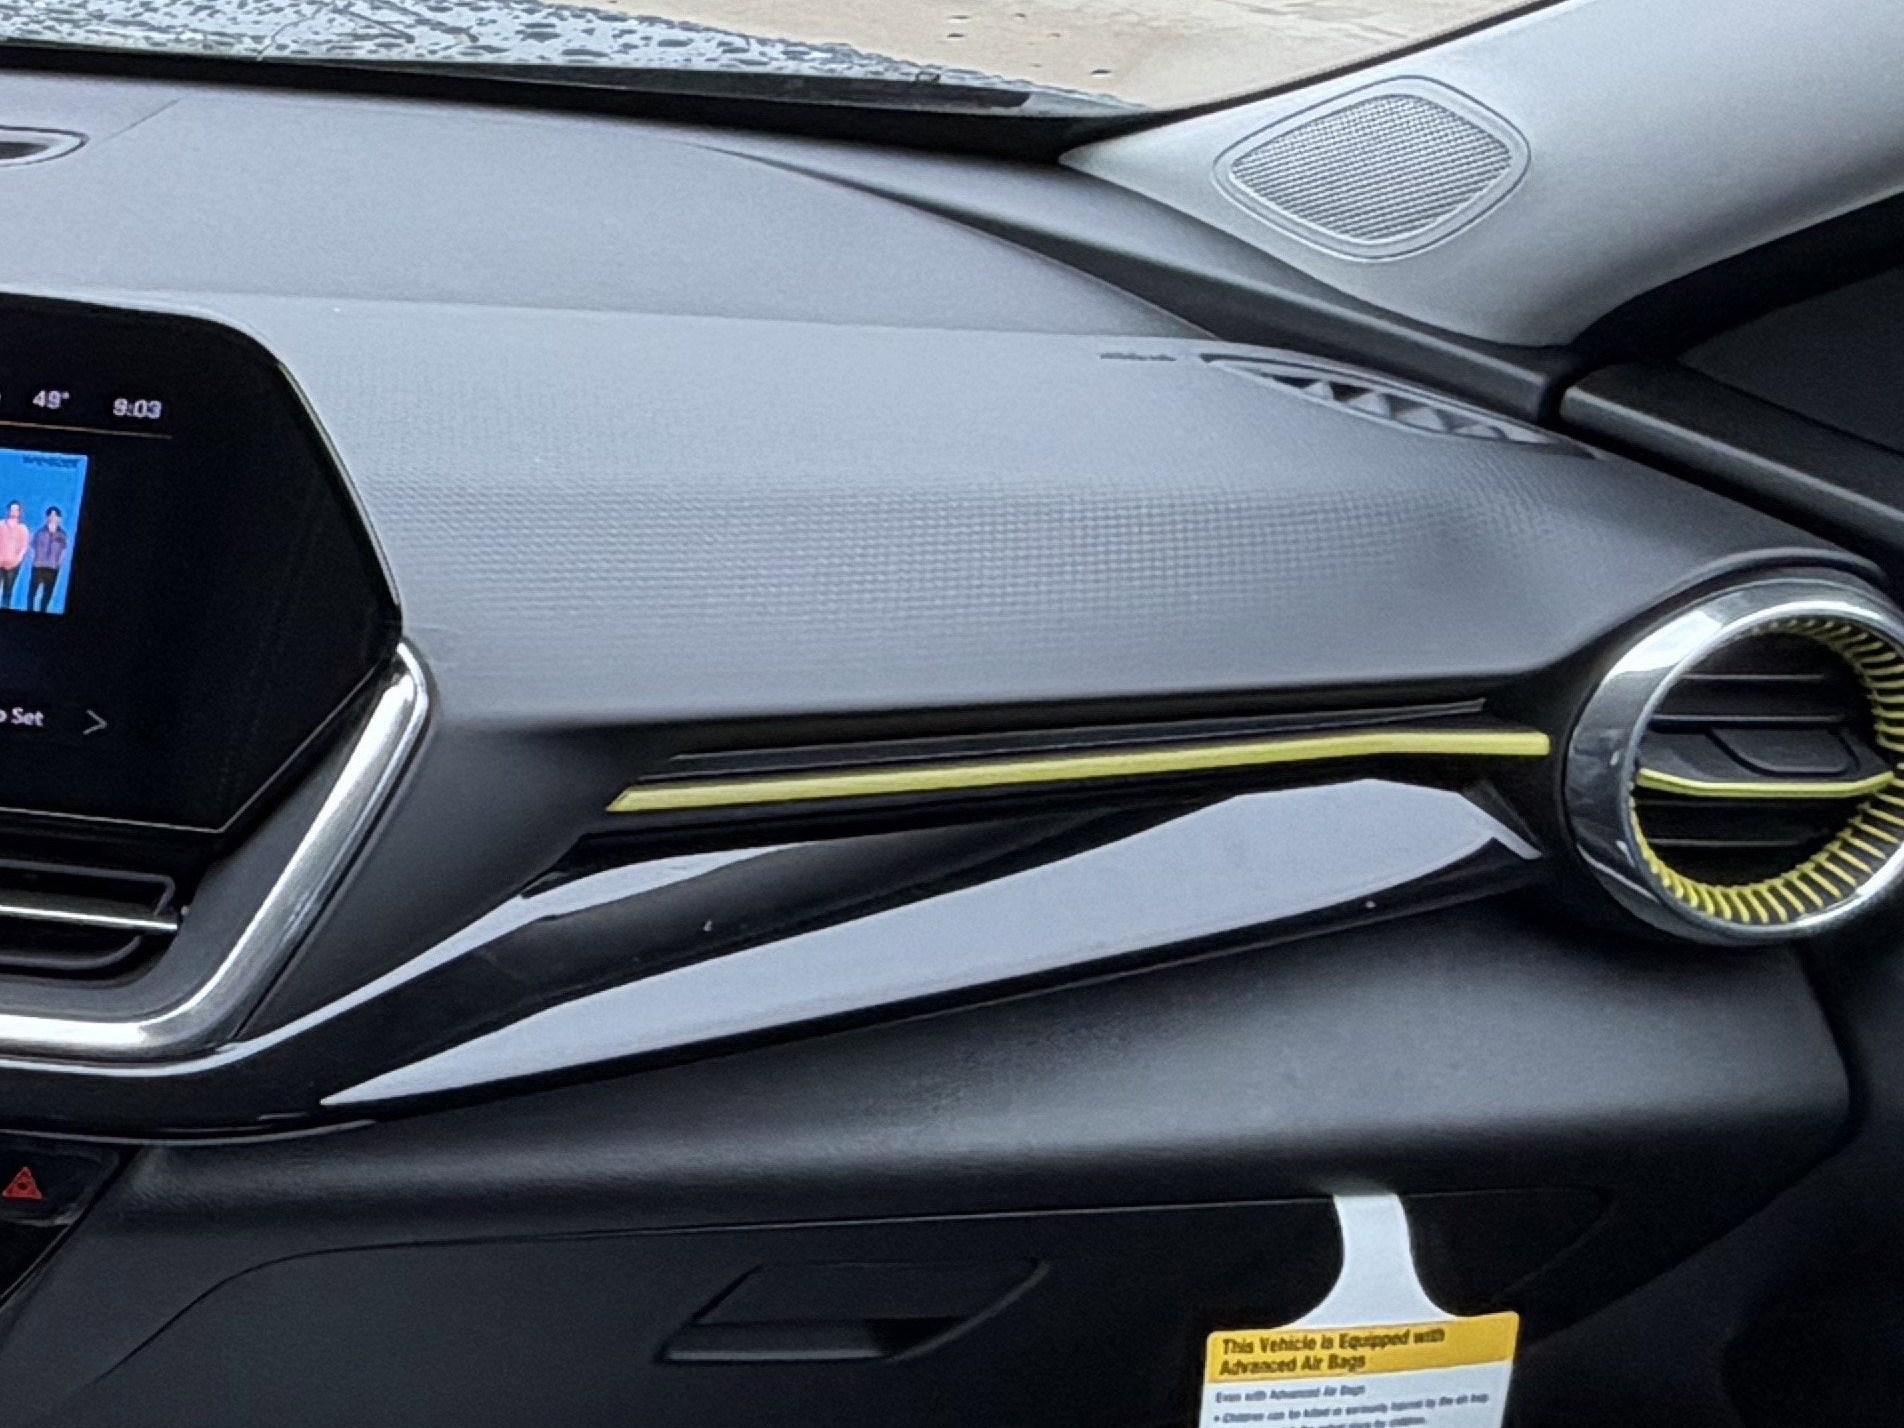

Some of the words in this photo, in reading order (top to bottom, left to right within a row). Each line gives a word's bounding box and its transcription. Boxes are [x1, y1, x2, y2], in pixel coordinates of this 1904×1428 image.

[11, 707, 45, 728] Set
[1222, 1337, 1254, 1355] This
[1259, 1334, 1317, 1354] Vehicle
[1338, 1328, 1411, 1351] Equipped
[1412, 1327, 1446, 1345] with
[1219, 1356, 1298, 1376] Advanced
[1300, 1354, 1324, 1372] Air
[1327, 1352, 1366, 1371] Bags
